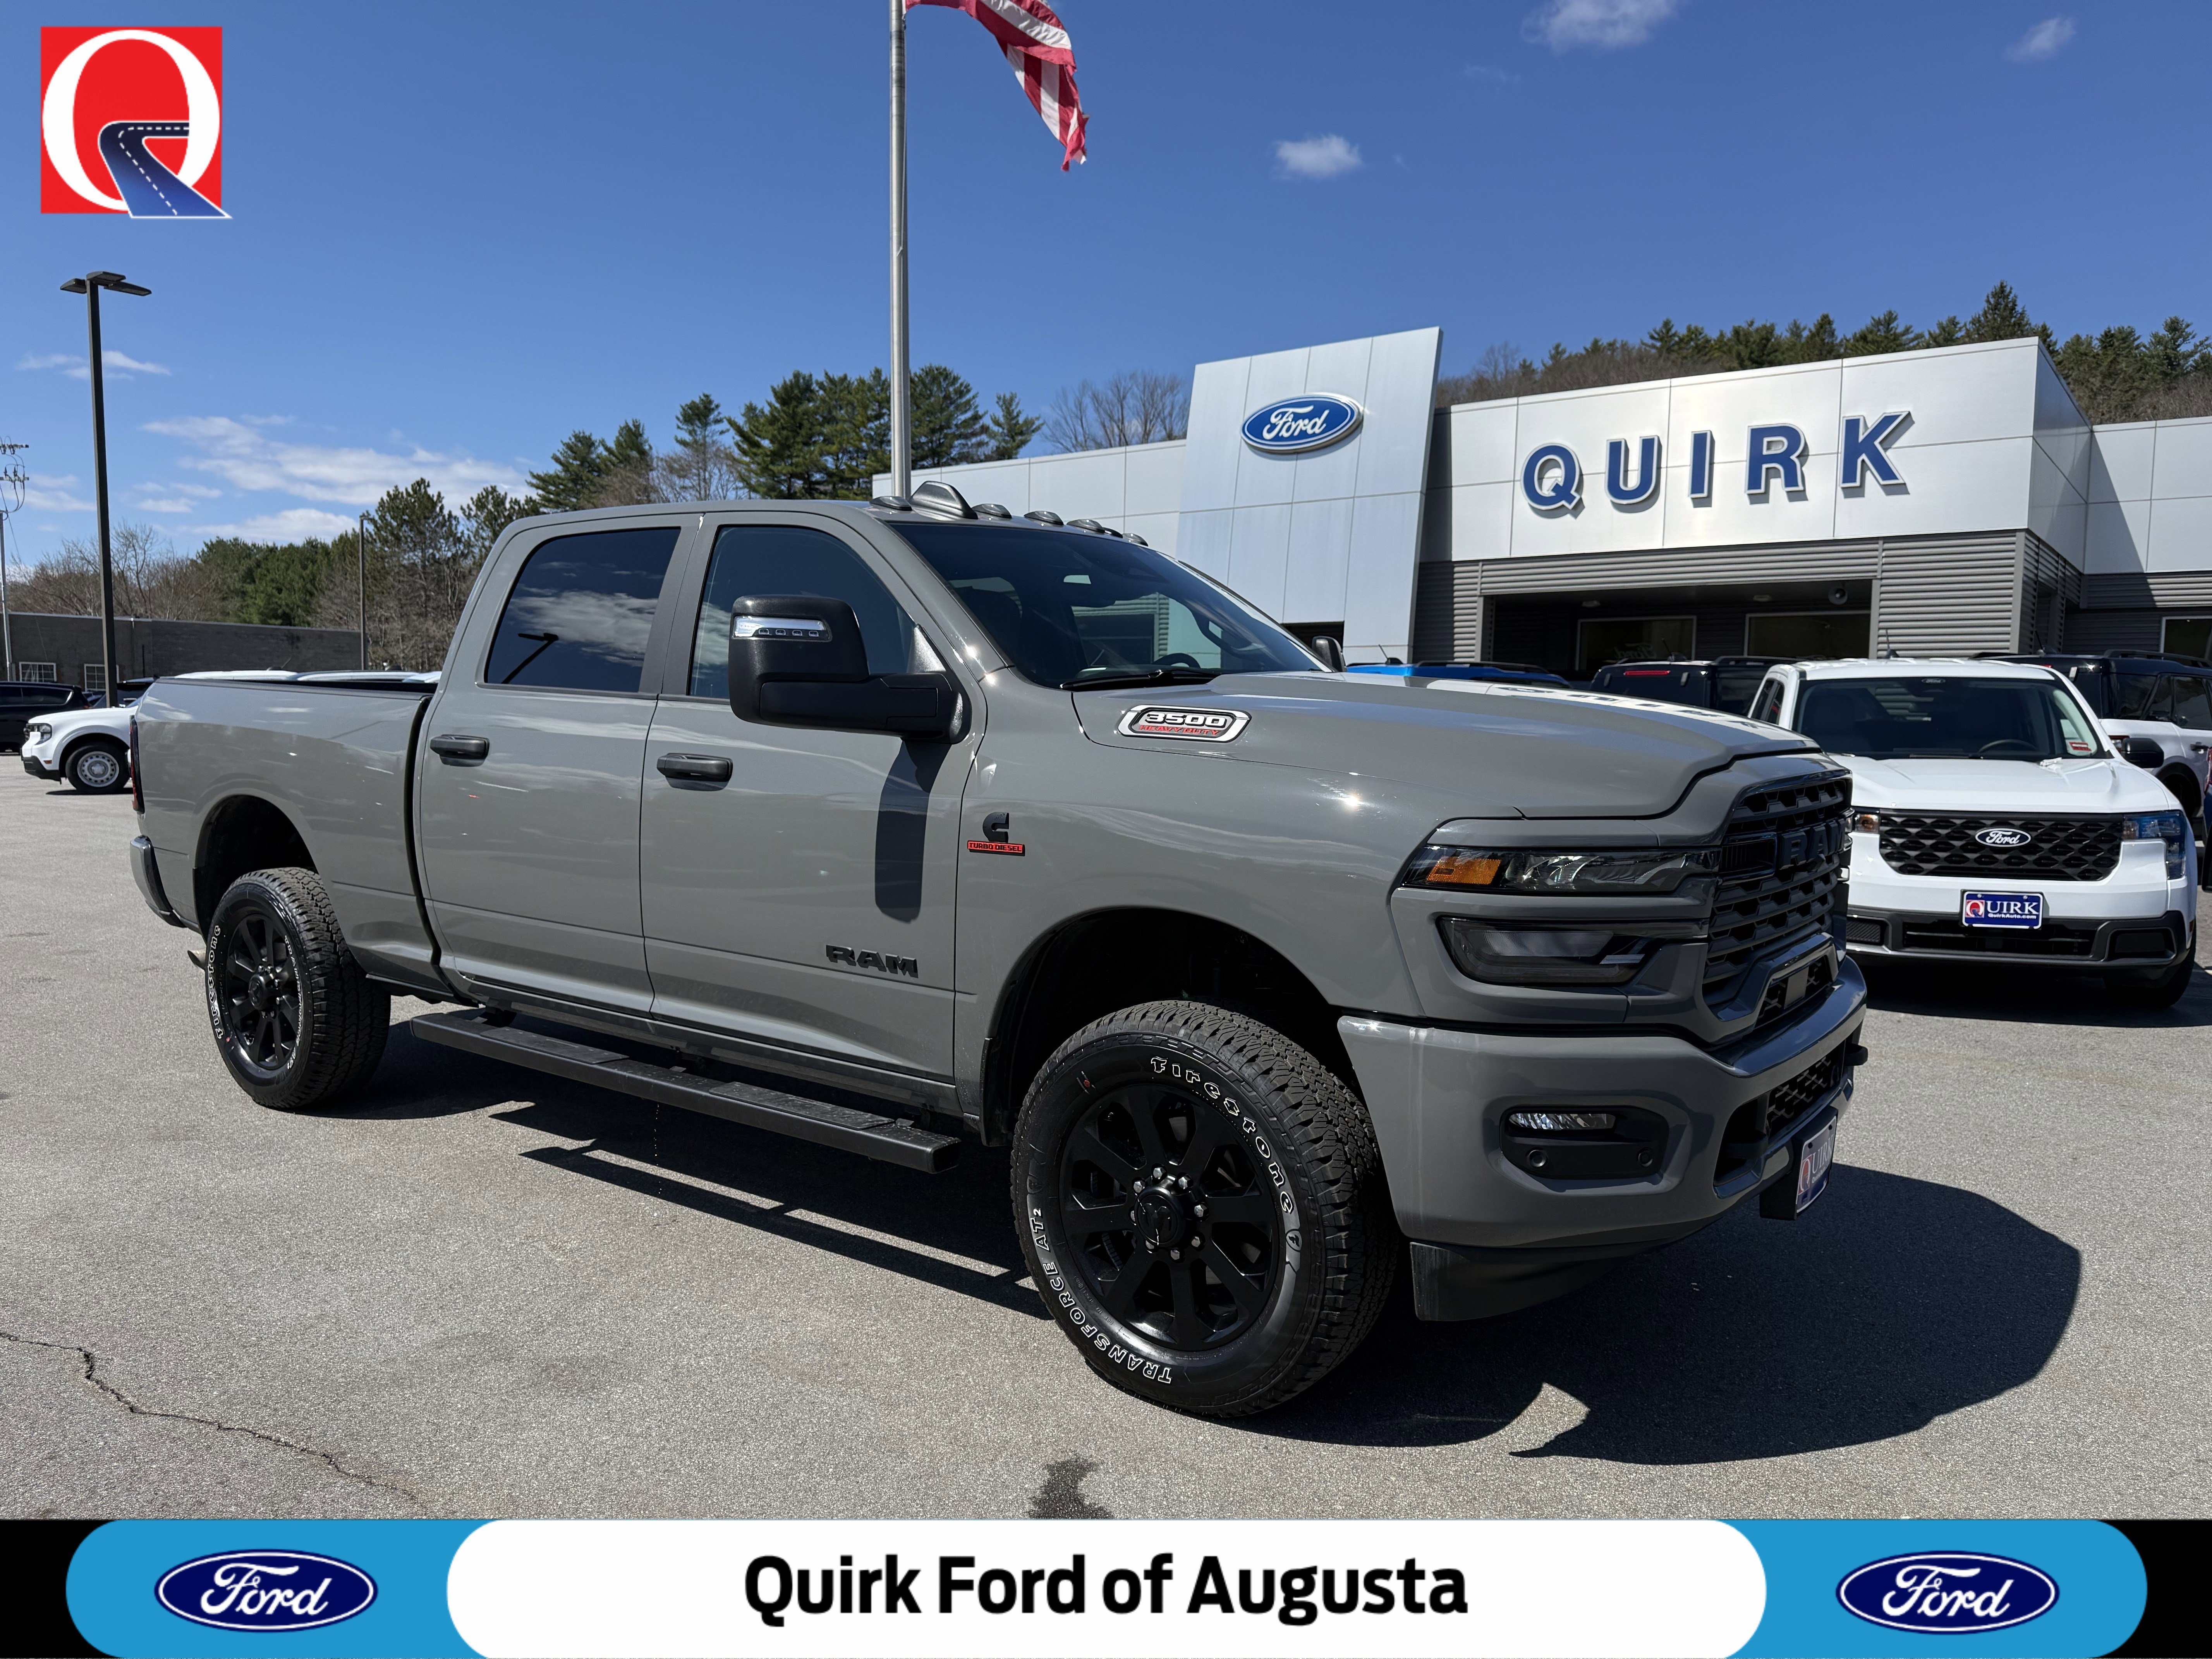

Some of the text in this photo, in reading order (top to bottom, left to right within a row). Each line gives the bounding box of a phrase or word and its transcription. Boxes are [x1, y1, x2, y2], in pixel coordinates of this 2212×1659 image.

[1262, 405, 1330, 440] Ford
[1520, 410, 1910, 510] QUIRK
[1146, 712, 1227, 728] 3500
[1779, 818, 1845, 870] RAM
[1986, 831, 2020, 844] Ford
[1966, 900, 2039, 918] QUIRK
[208, 925, 223, 1039] Firestone
[826, 944, 919, 979] RAM
[1151, 1056, 1294, 1214] Firestone
[1029, 1208, 1173, 1384] TRANSFORCE AT2
